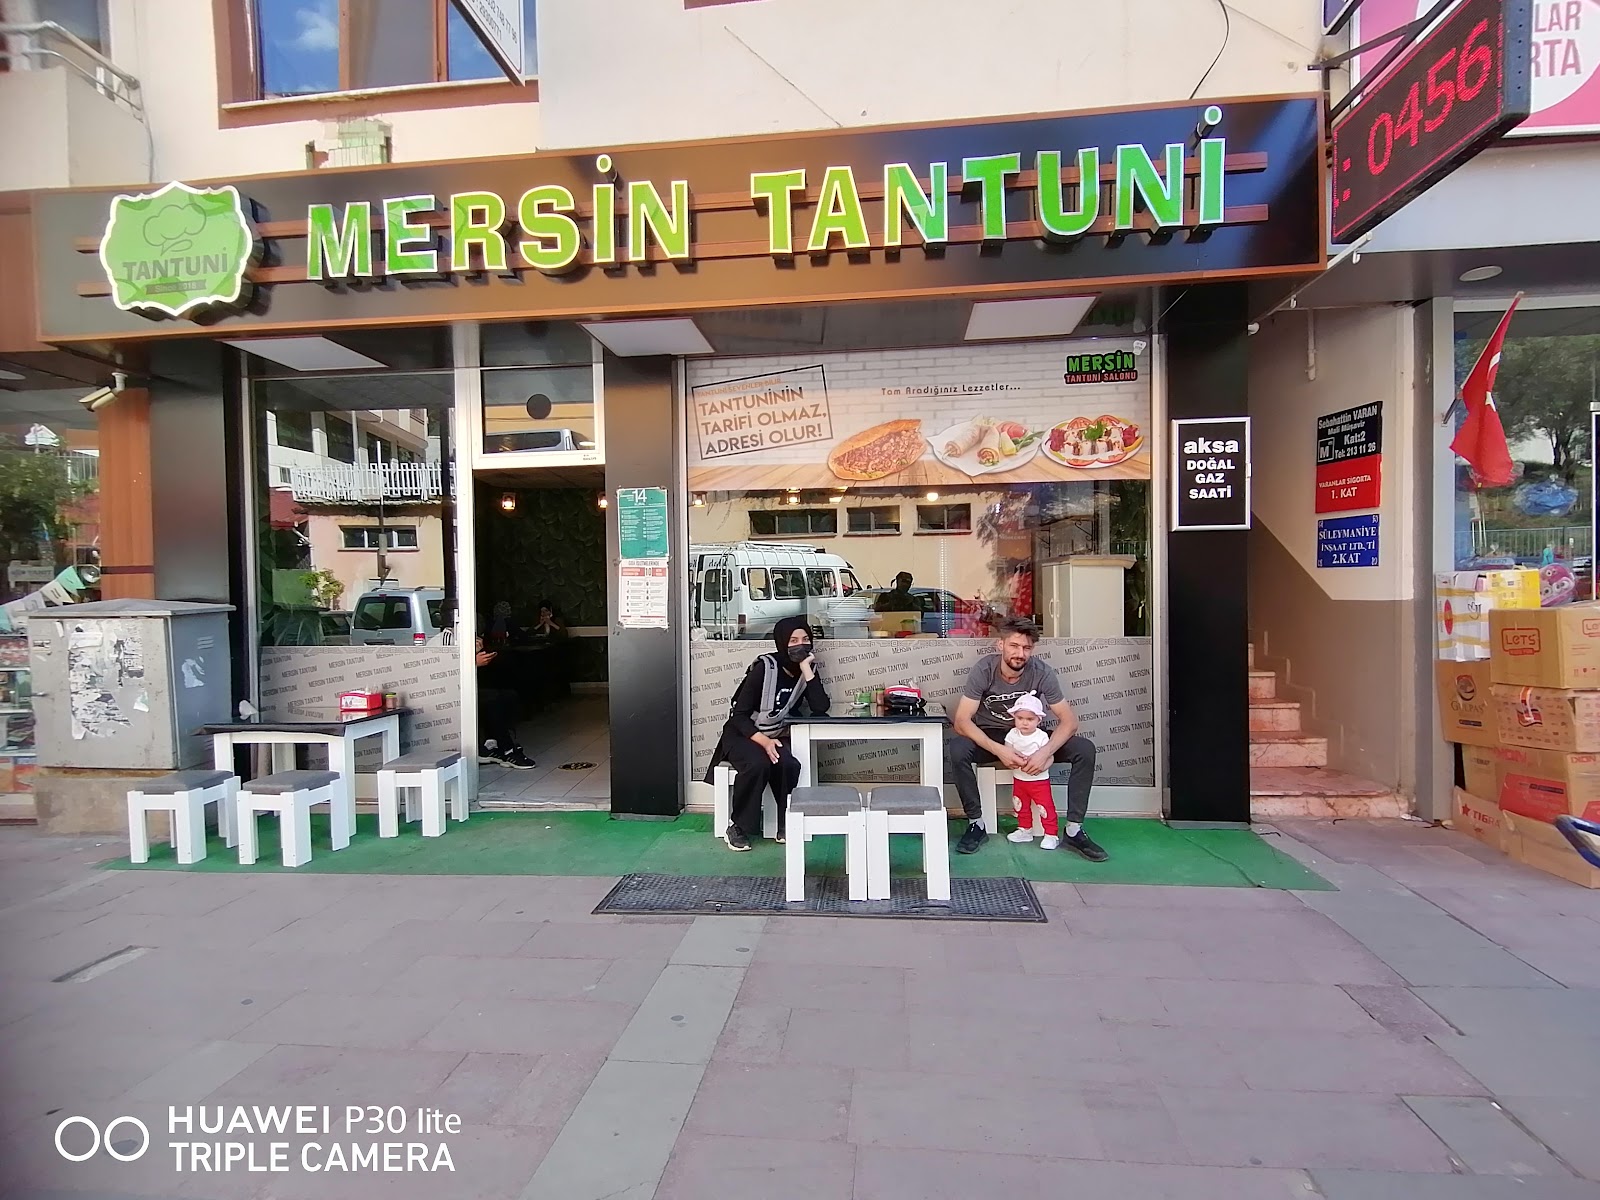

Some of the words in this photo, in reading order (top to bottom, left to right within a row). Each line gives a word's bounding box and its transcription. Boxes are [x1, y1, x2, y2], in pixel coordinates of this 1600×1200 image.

[1367, 18, 1492, 175] 0456
[307, 154, 689, 281] MERSİN
[750, 105, 1226, 254] TANTUNİ
[122, 247, 228, 281] TANTUNİ
[1068, 351, 1133, 373] MERSİN
[1103, 372, 1137, 381] SALONU
[698, 385, 804, 417] TANTUNİNİN
[701, 412, 753, 436] TARİFİ
[757, 404, 827, 426] OLMAZ,
[1353, 405, 1378, 421] VARAN
[705, 429, 764, 455] ADRESİ
[768, 423, 823, 444] OLUR!
[1344, 431, 1366, 445] Kat:2
[1183, 437, 1240, 454] aksa
[1346, 446, 1358, 457] 213
[1186, 457, 1236, 471] DOĞAL
[1195, 473, 1225, 484] GAZ
[632, 489, 648, 503] 14
[1189, 485, 1232, 499] SAATİ
[1340, 487, 1358, 498] KAT
[1318, 526, 1377, 540] SÜLEYMANİYE
[1332, 553, 1361, 564] 2.KAT
